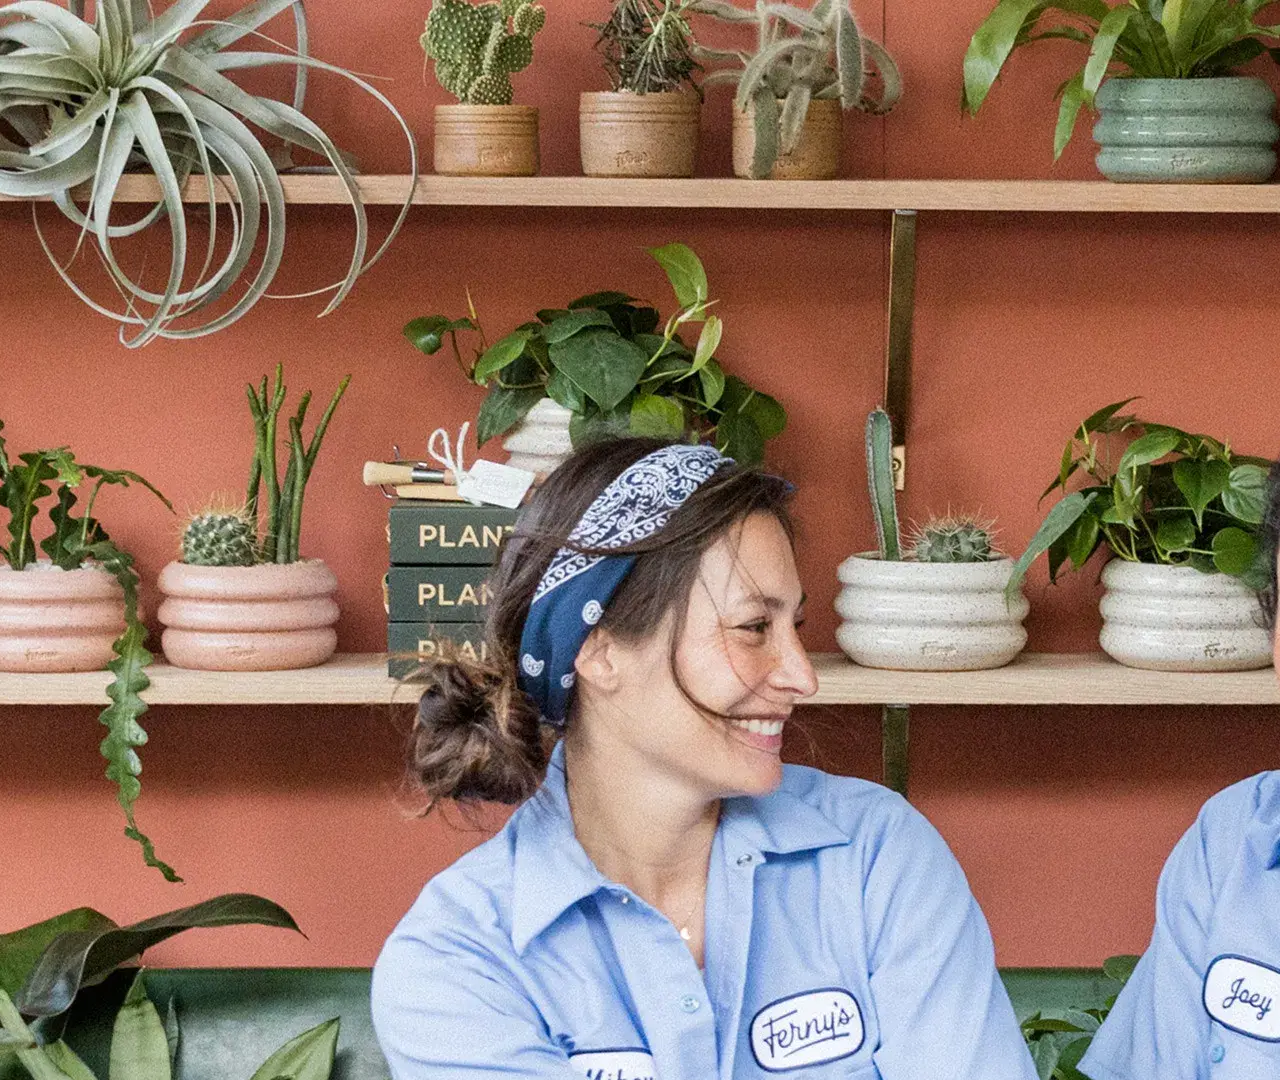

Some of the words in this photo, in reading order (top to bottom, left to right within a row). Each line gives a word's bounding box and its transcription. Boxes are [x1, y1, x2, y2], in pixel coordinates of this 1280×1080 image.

[419, 524, 515, 548] PLAN
[1222, 977, 1272, 1021] Joey
[763, 1001, 855, 1058] Ferny's
